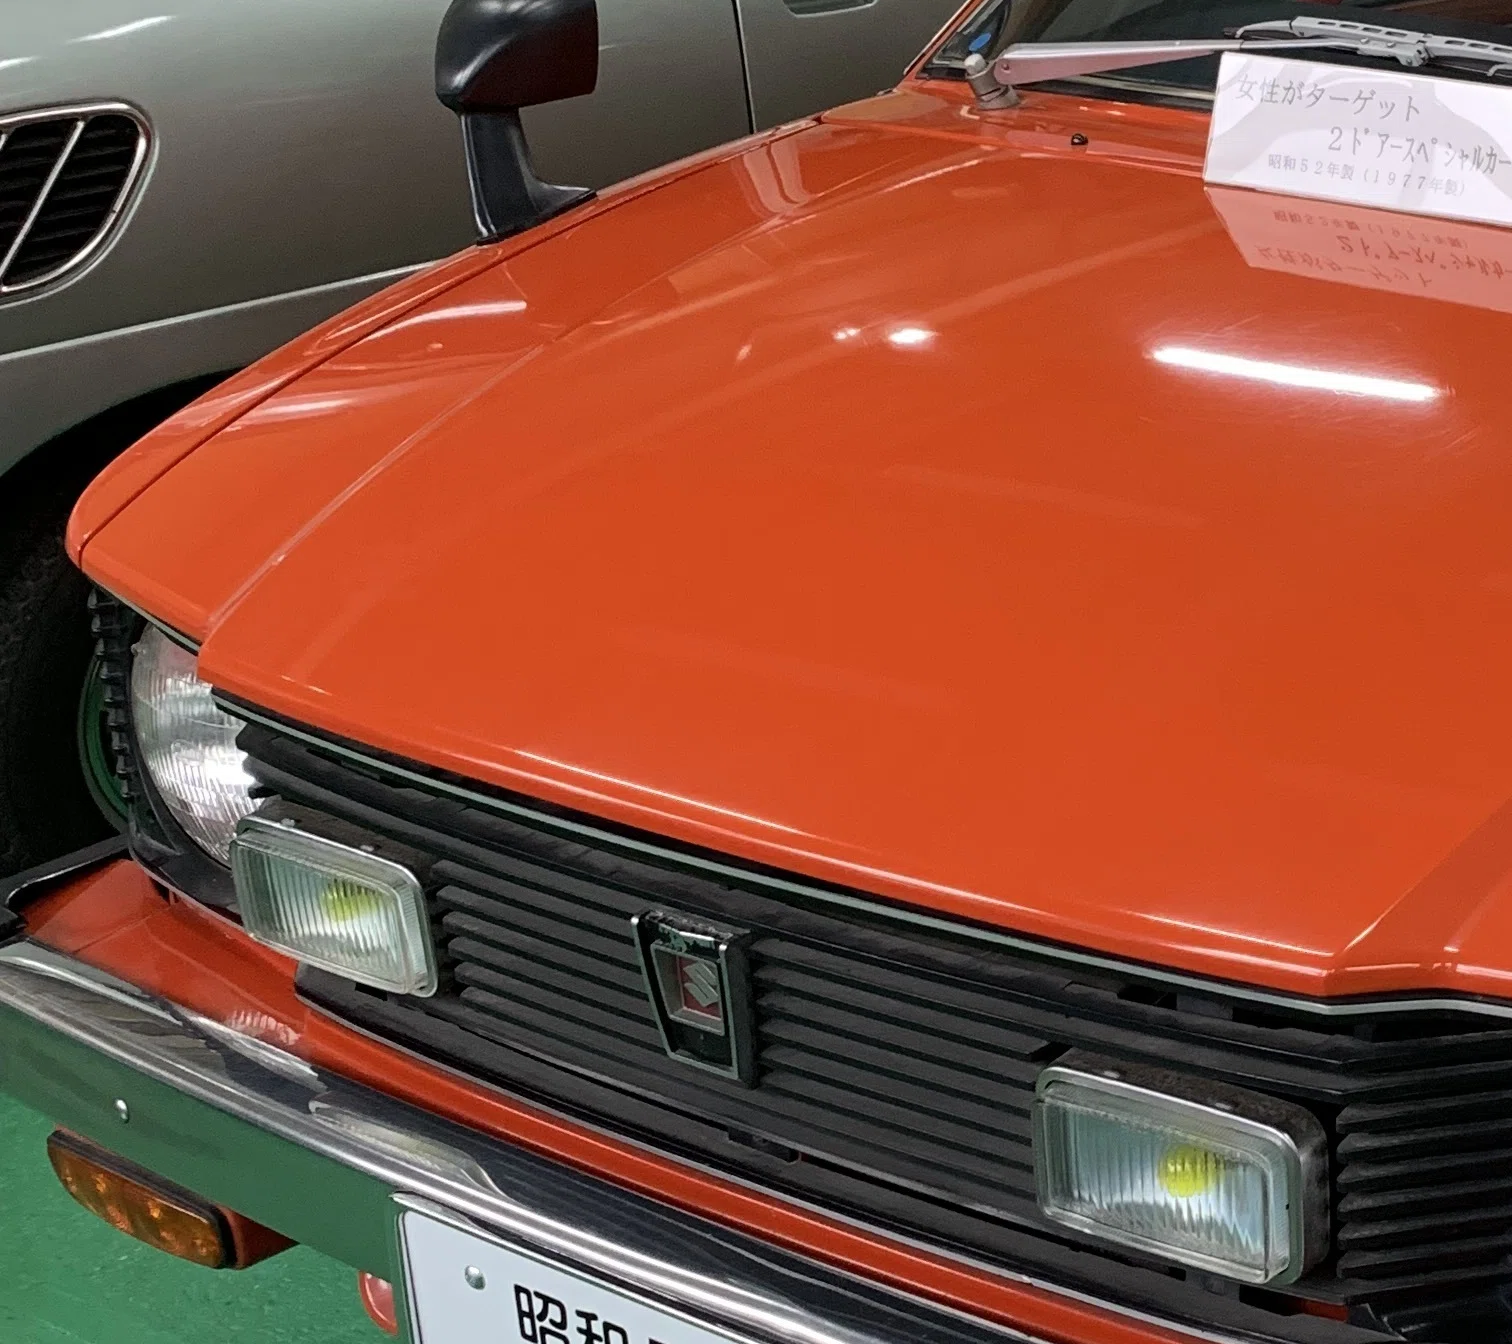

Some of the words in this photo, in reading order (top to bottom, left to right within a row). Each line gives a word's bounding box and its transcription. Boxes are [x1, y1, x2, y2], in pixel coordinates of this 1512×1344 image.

[1234, 73, 1421, 122] 女性がターゲット
